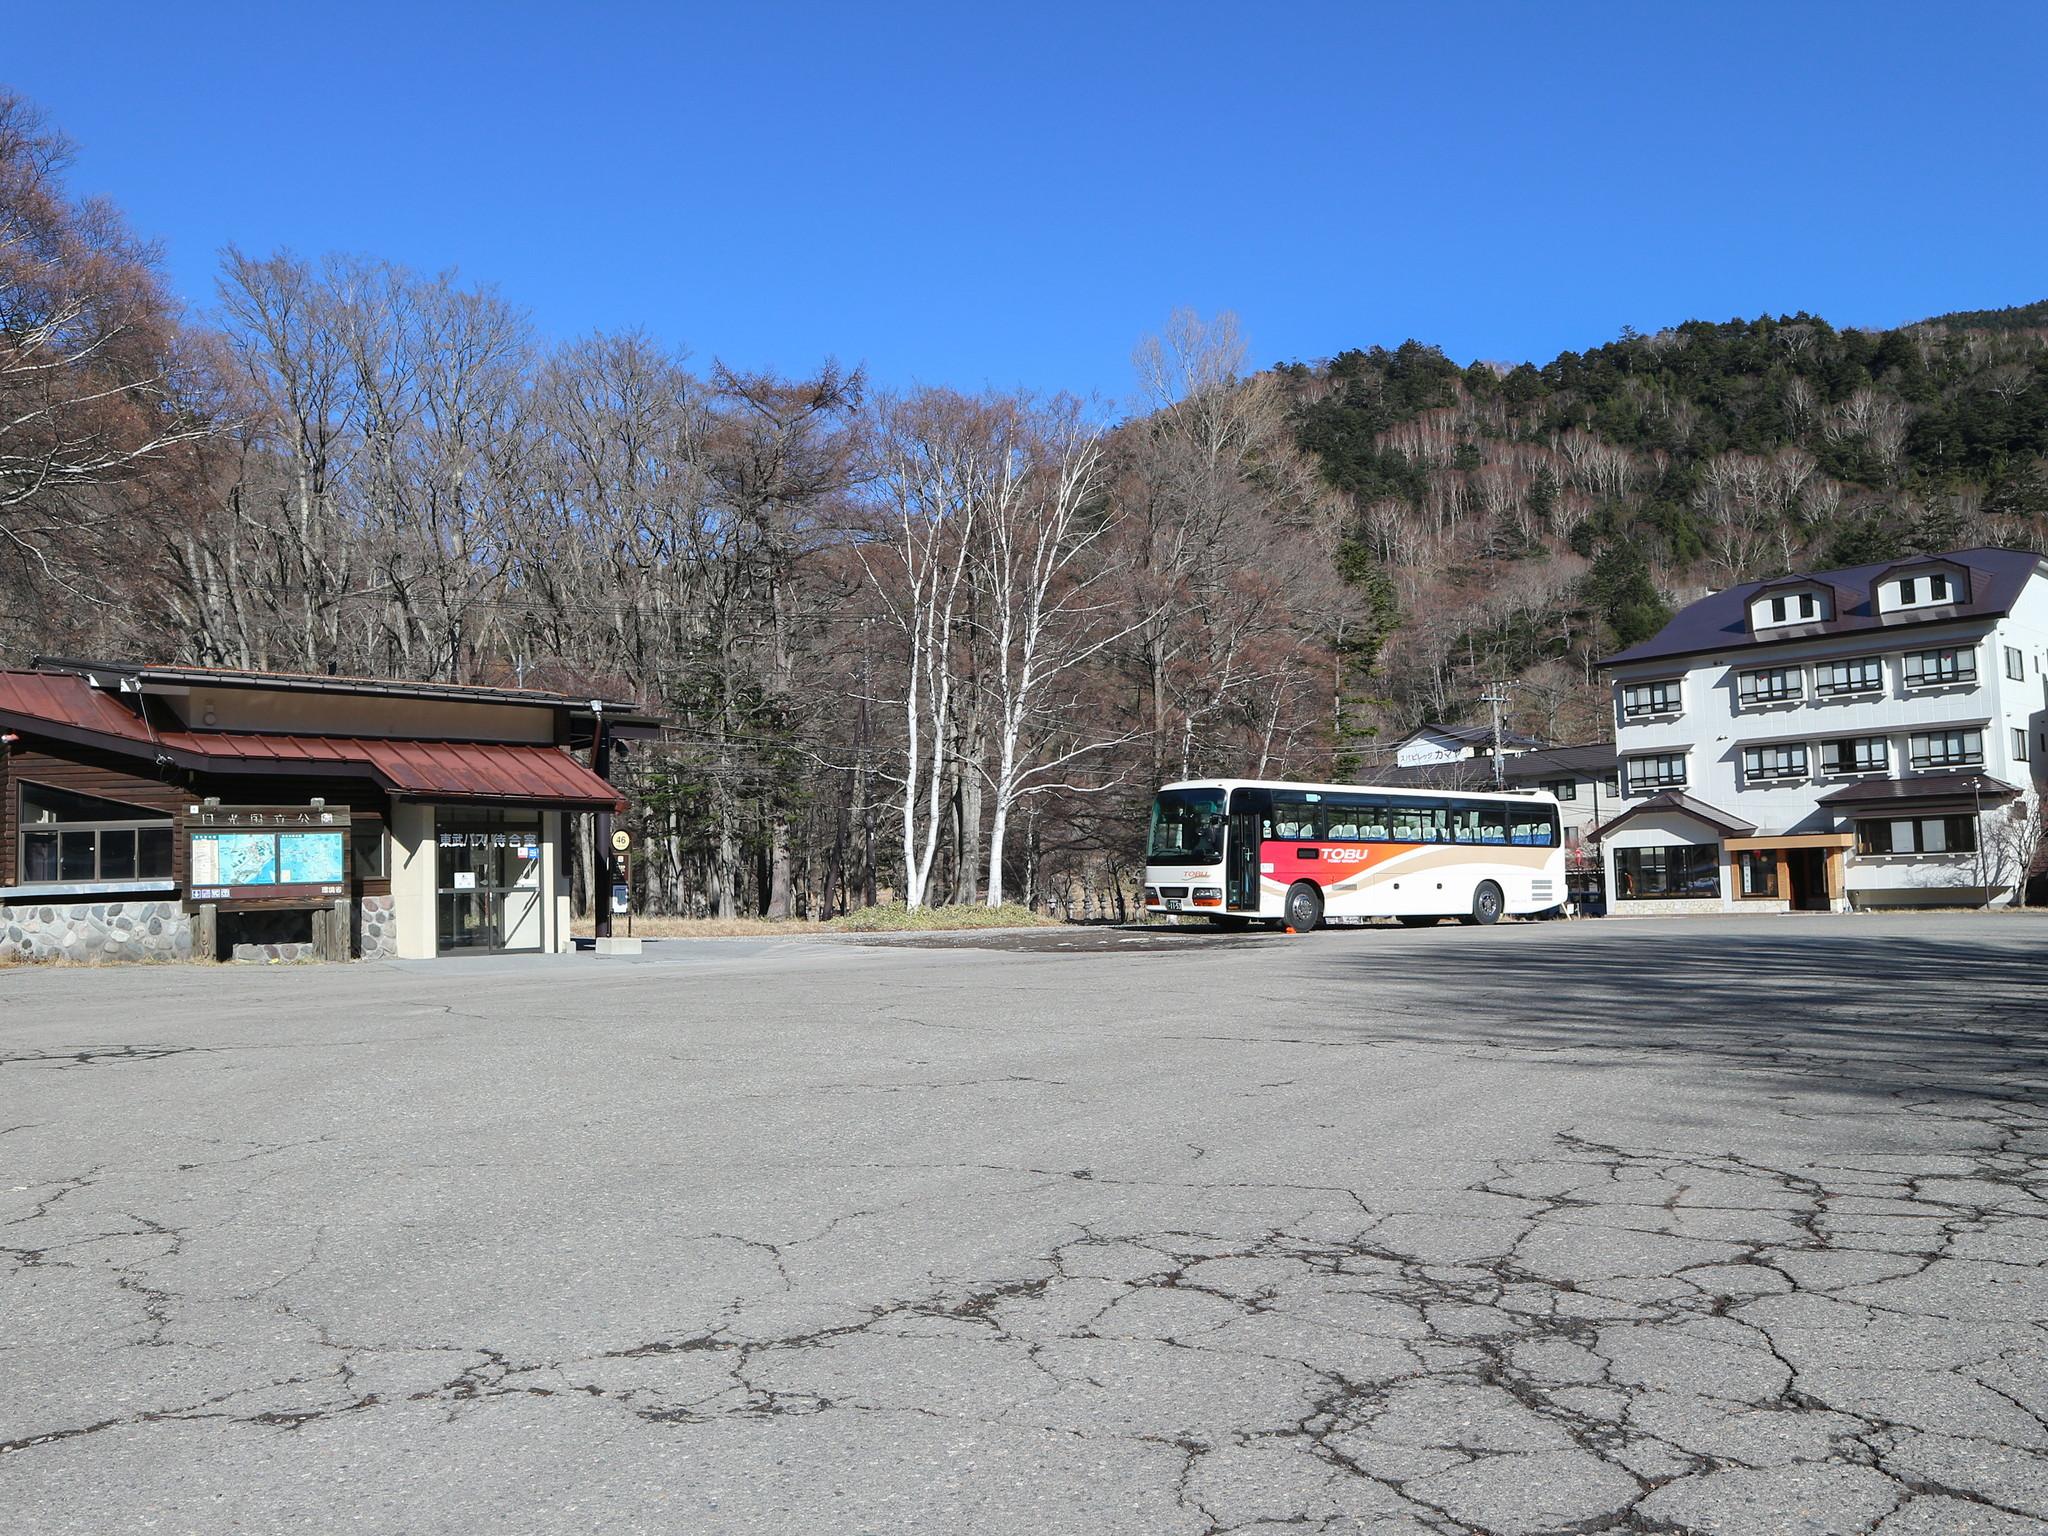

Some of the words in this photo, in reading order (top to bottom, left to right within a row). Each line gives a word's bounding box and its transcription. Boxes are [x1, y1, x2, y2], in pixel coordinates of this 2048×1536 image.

[493, 833, 537, 848] 待合室
[616, 836, 626, 845] 46
[1321, 848, 1369, 860] TOBU
